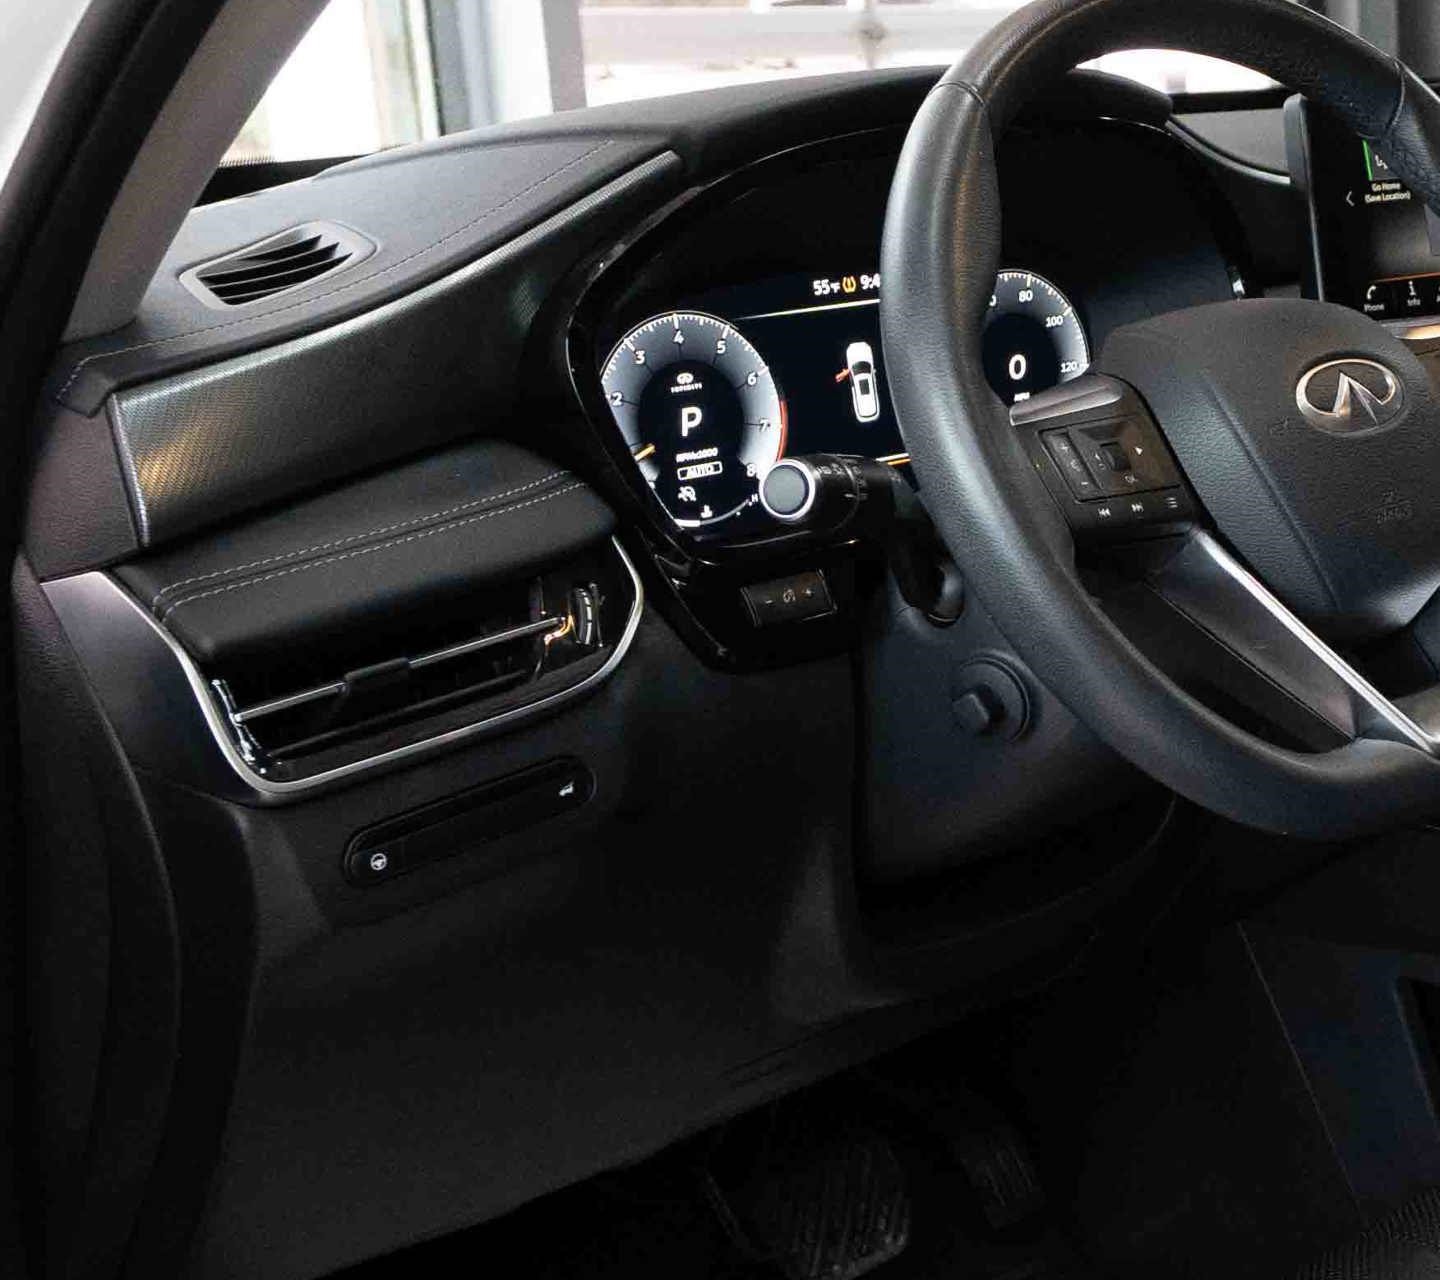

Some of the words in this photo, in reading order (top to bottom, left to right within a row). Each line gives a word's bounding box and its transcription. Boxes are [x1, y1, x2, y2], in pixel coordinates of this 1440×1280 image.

[1019, 290, 1033, 302] 80
[1046, 315, 1063, 328] 100
[673, 331, 684, 344] 4
[716, 341, 726, 354] 5
[635, 350, 646, 365] 3
[1008, 353, 1027, 380] 0
[1061, 361, 1077, 373] 120
[747, 373, 757, 386] 6
[612, 393, 623, 406] 2
[681, 406, 703, 437] P
[759, 421, 769, 433] 7
[746, 463, 757, 477] 8
